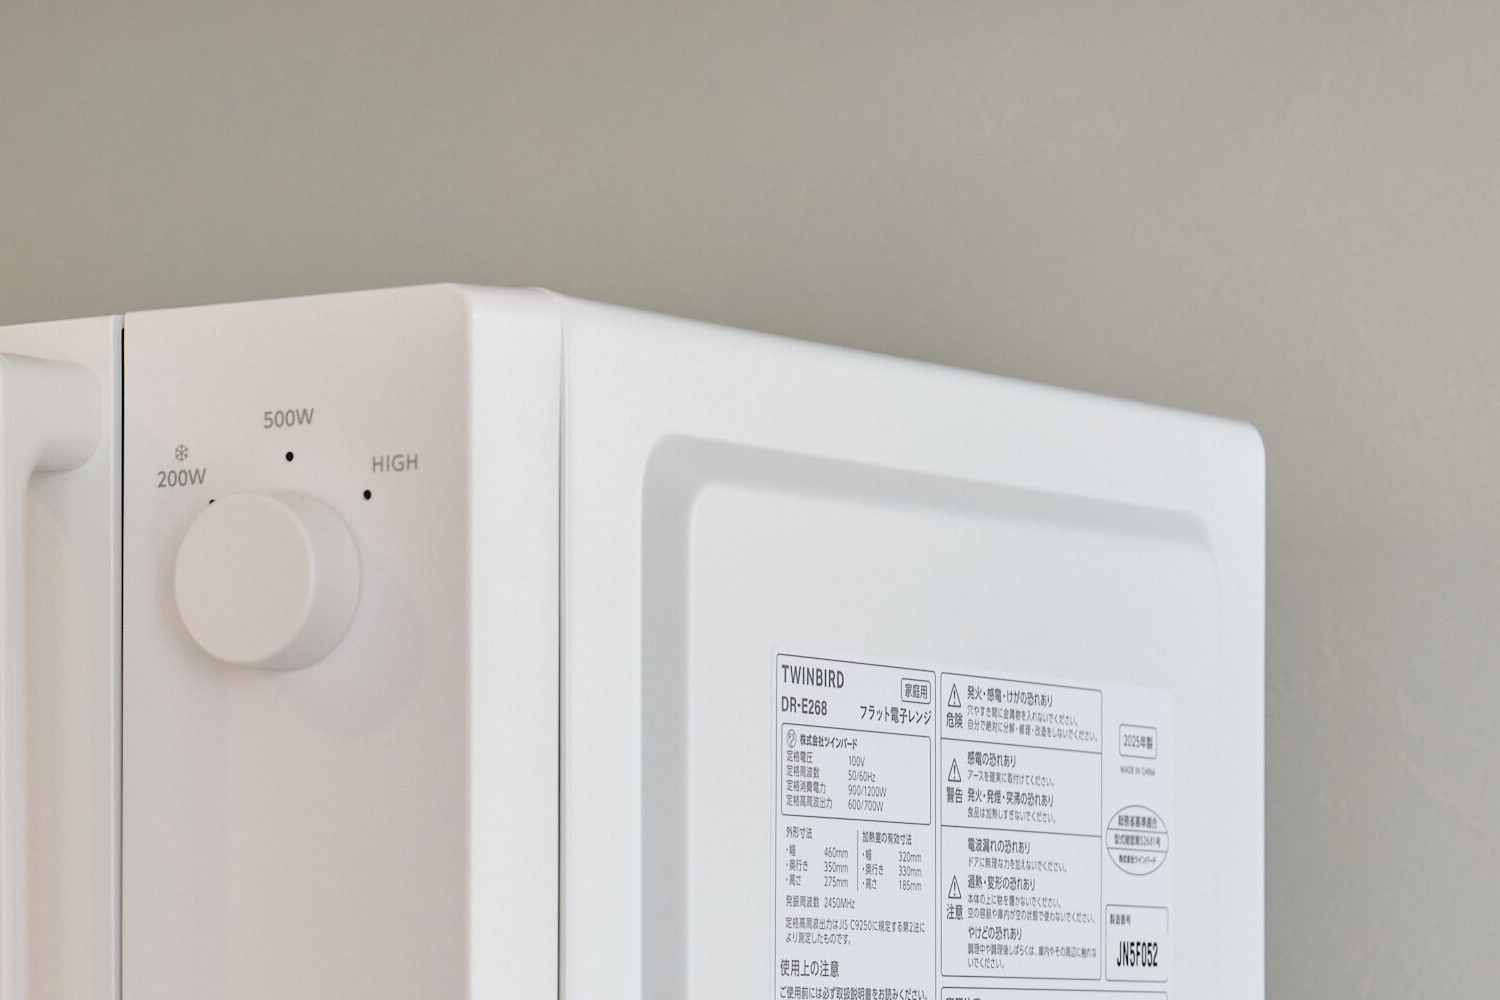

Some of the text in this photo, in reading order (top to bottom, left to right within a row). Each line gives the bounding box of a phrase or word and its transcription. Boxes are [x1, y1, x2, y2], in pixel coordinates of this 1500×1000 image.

[263, 408, 315, 429] 500W
[372, 454, 419, 473] HIGH
[157, 468, 207, 488] 200W
[781, 664, 845, 689] TWINBIRD
[904, 683, 928, 700] 家庭用
[967, 685, 1053, 708] 発火・感電・けがの恐れあり
[781, 696, 828, 716] DR-E268
[860, 704, 932, 725] フラット電子レンジ
[946, 712, 963, 729] 危険
[800, 733, 858, 750] 株式会社ツインバード
[1123, 734, 1154, 750] 2025年製
[786, 750, 866, 768] 定格電圧 100V
[967, 751, 1017, 768] 感電の恐れあり
[848, 770, 876, 783] 50/60Hz
[848, 784, 887, 798] 900/1200W
[946, 786, 963, 804] 警告
[848, 799, 884, 812] 600/700W
[786, 825, 813, 840] 外形寸法
[824, 847, 849, 859] 460mm
[967, 837, 1031, 855] 電波漏れの恐れあり
[898, 851, 922, 863] 320mm
[824, 861, 849, 873] 350mm
[898, 865, 922, 878] 330mm
[824, 876, 849, 888] 275mm
[899, 879, 922, 892] 185mm
[967, 874, 1036, 892] 過熱・変形の恐れあり
[824, 896, 856, 910] 2450MHz
[946, 903, 963, 921] 注意
[967, 926, 1022, 941] やけどの恐れあり
[1116, 940, 1159, 968] JN5F052
[780, 959, 840, 978] 使用上の注意
